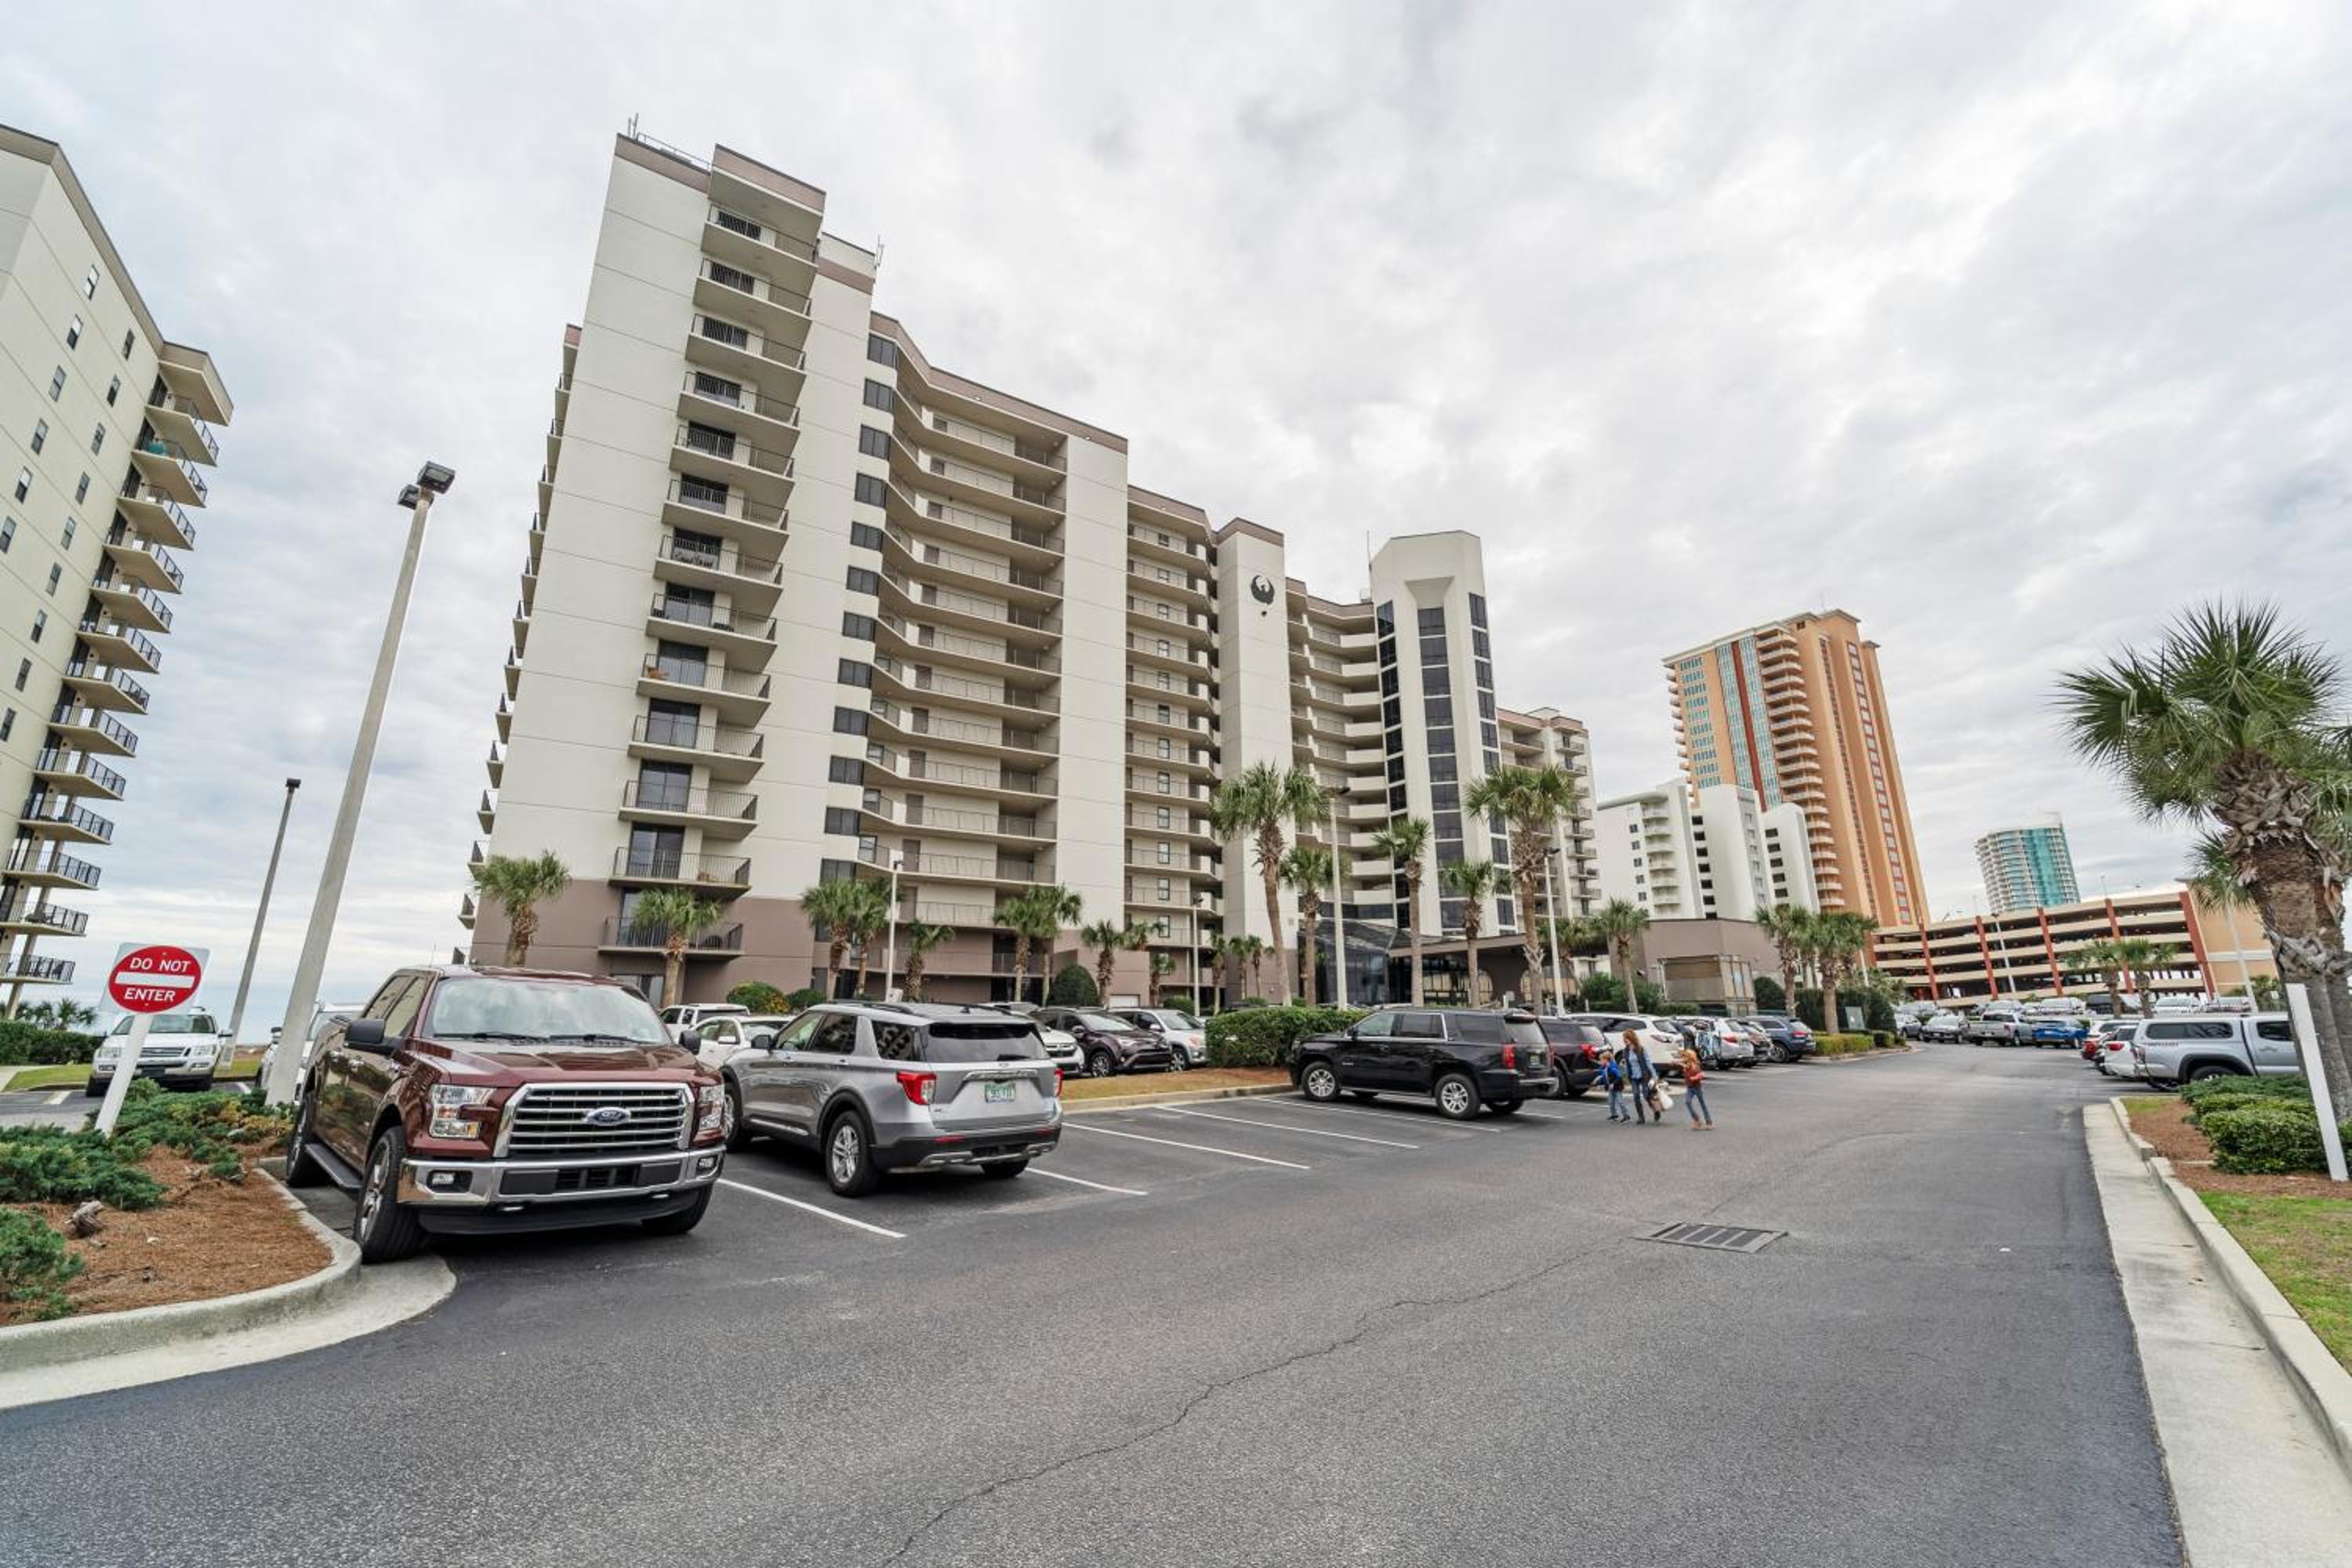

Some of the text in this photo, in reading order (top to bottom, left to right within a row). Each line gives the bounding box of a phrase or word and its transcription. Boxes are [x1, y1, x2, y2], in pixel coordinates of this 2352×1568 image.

[129, 957, 191, 972] DO NOT
[124, 988, 176, 1002] ENTER
